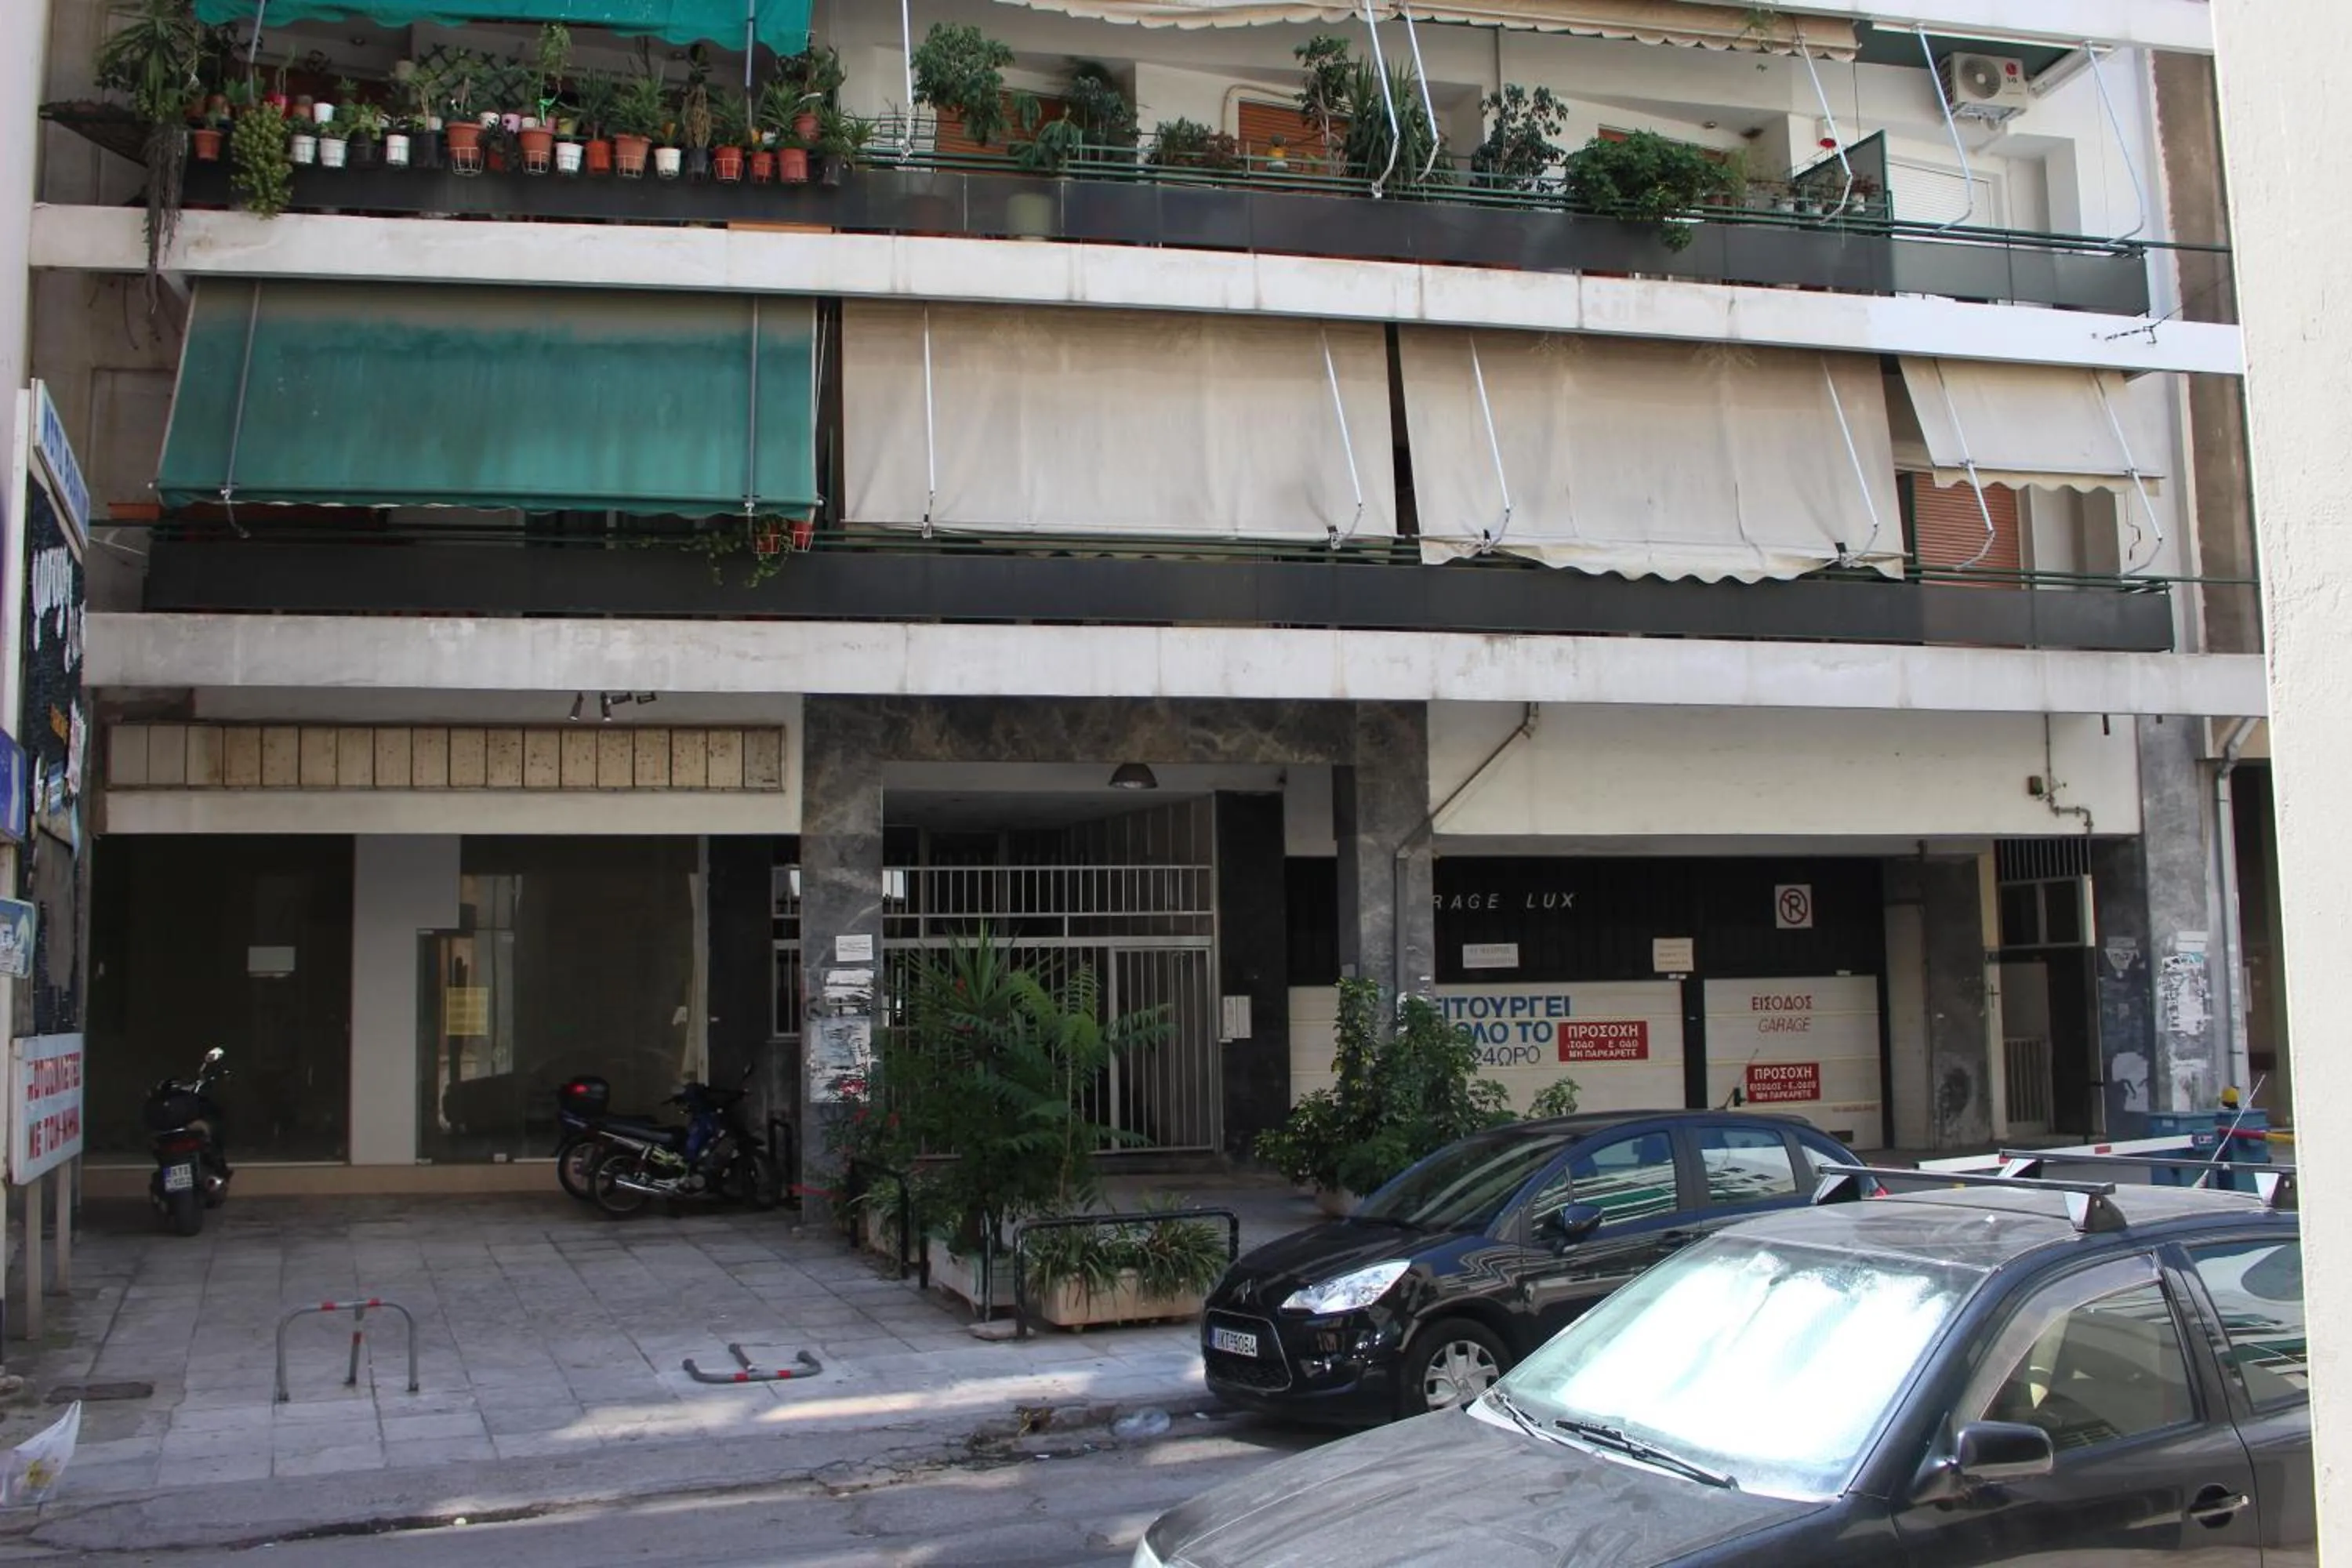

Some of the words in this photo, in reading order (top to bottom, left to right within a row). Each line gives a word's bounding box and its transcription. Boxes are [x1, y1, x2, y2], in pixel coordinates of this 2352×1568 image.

[1526, 892, 1574, 909] LUX
[1751, 996, 1813, 1011] ΕΙΣΟΔΟΣ
[1515, 1021, 1553, 1044] ΤΟ
[1568, 1024, 1639, 1038] ΠΡΟΣΟΧΗ
[1759, 1018, 1811, 1033] GARAGE
[1755, 1066, 1813, 1080] ΠΡΟΣΟΧΗ
